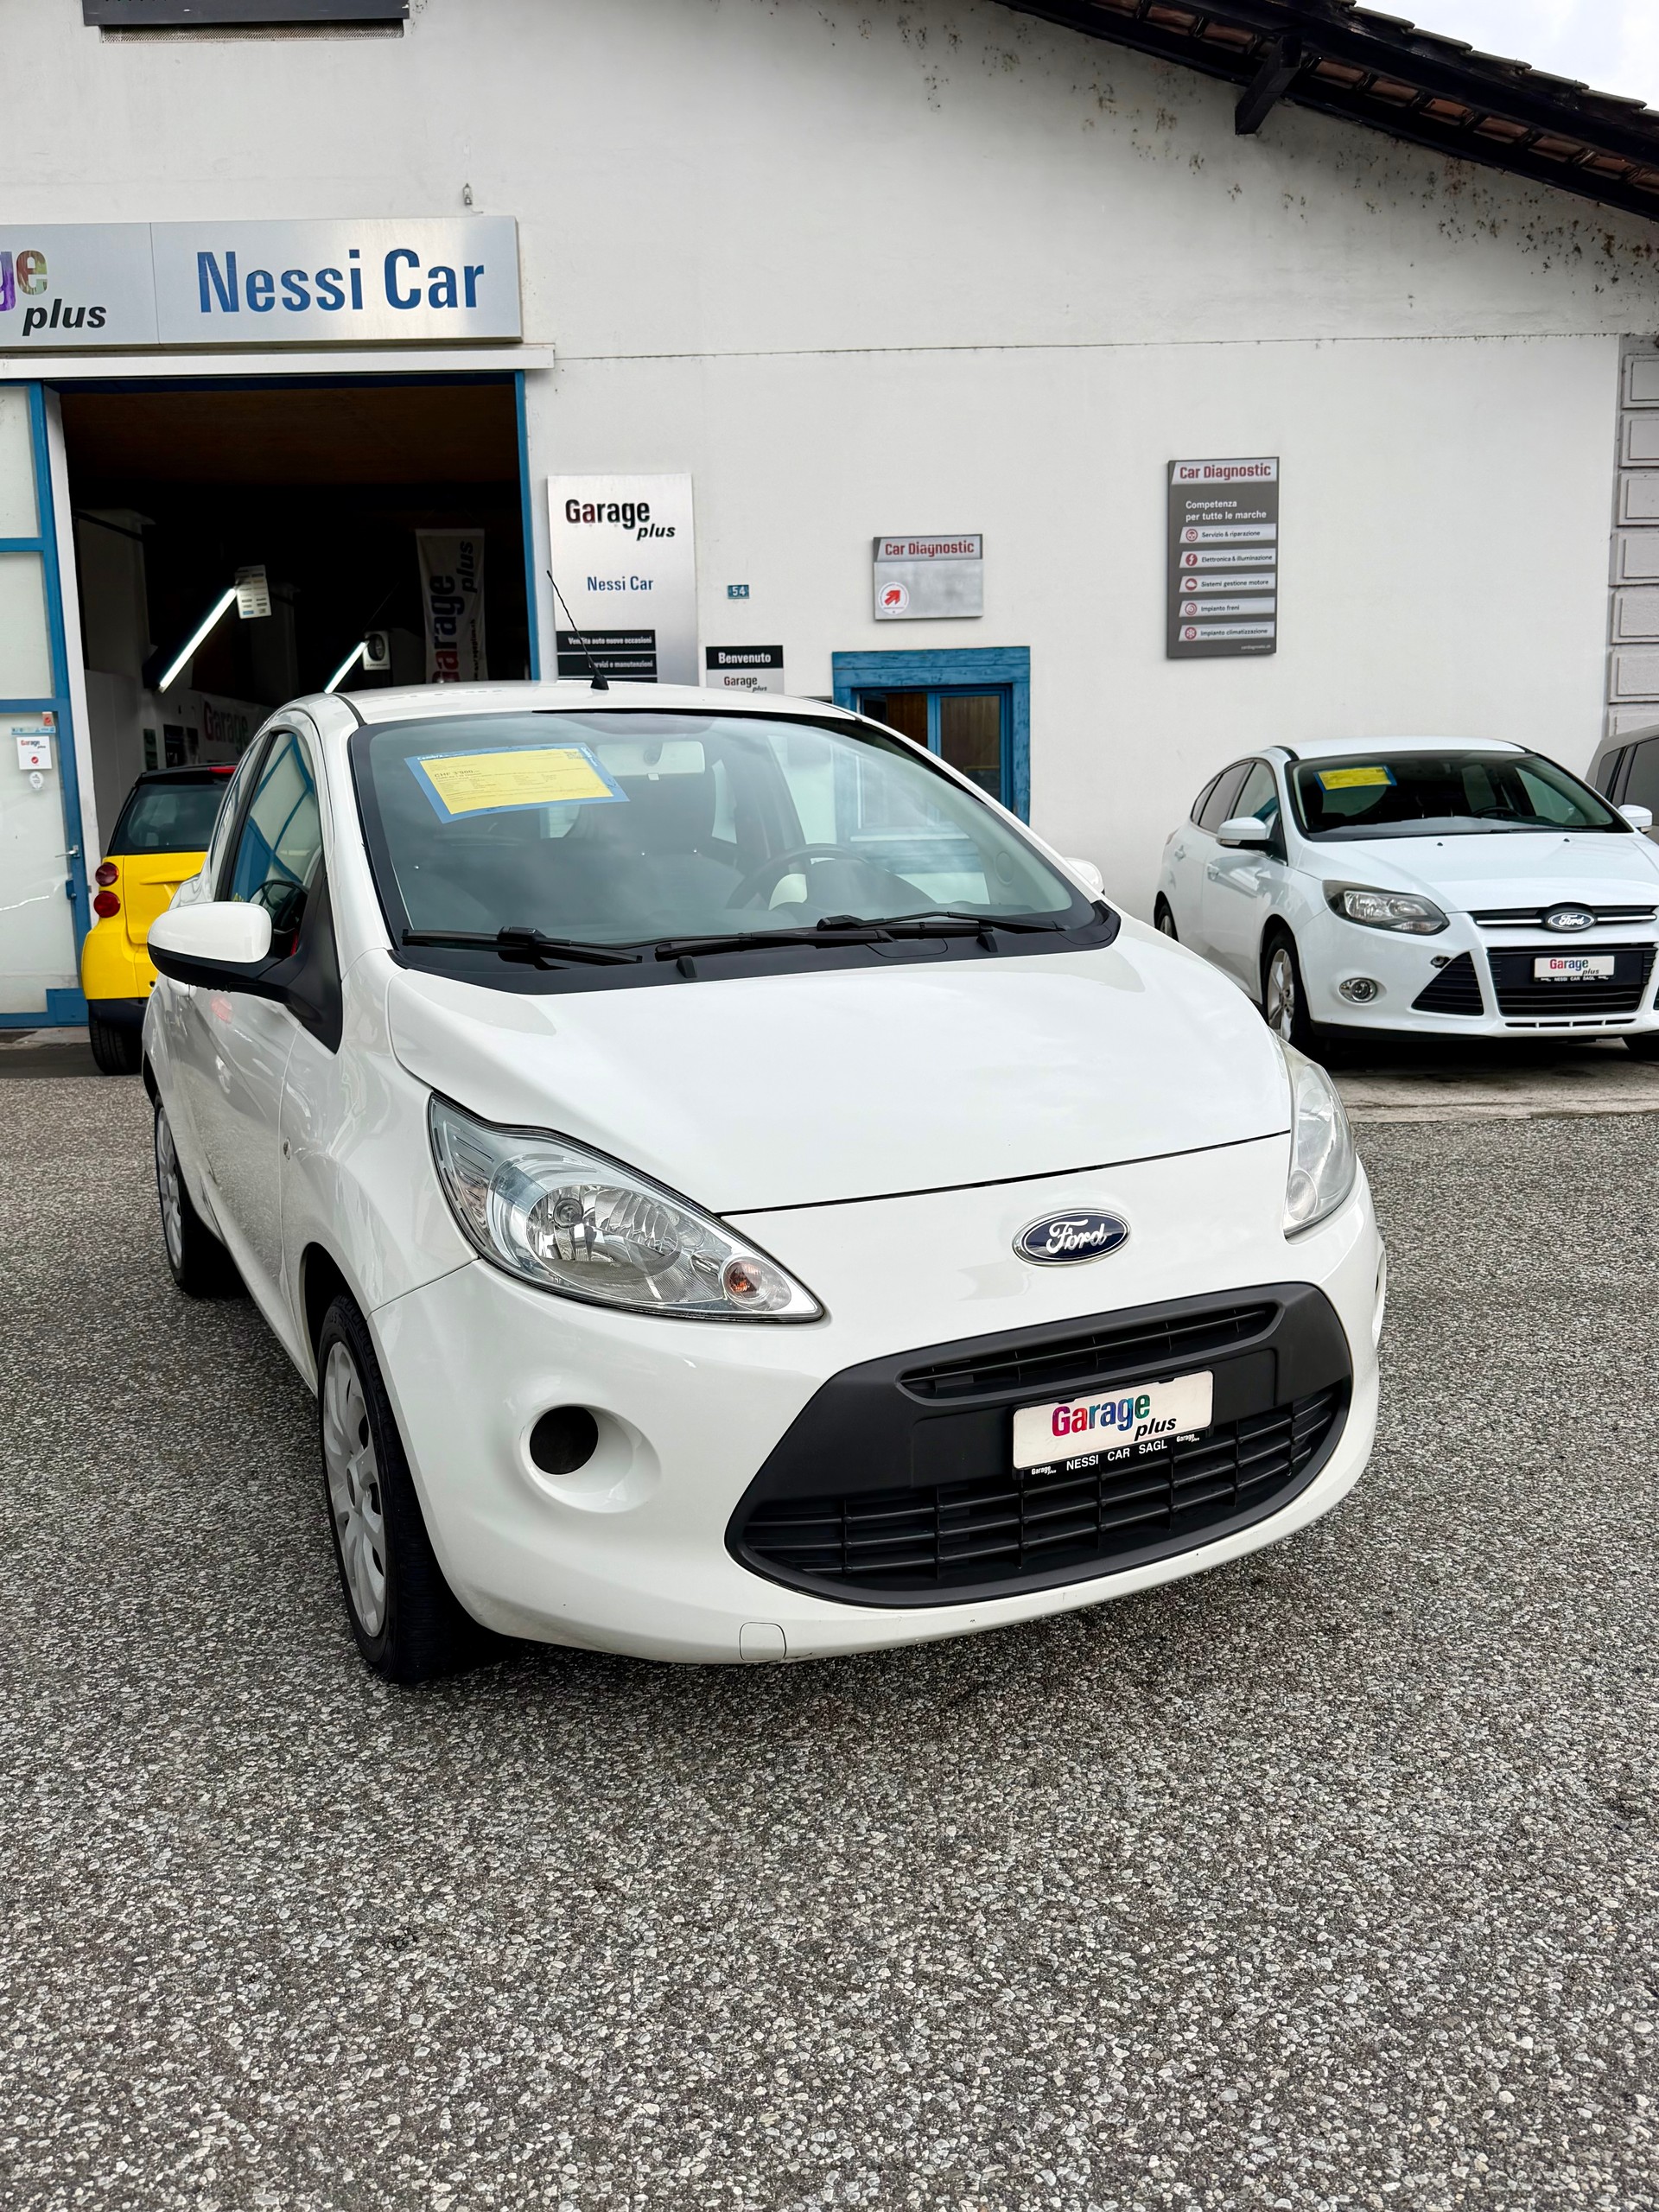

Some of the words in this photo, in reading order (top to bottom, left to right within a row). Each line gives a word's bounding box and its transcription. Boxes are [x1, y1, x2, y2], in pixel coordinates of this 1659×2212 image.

[197, 248, 363, 313] Nessi
[384, 248, 484, 310] Car
[22, 298, 107, 337] plus
[1179, 466, 1200, 479] Car
[1204, 462, 1271, 480] Diagnostic
[1185, 500, 1237, 510] Competenza
[565, 499, 651, 530] Garage
[1185, 513, 1200, 523] per
[1202, 512, 1223, 520] tutte
[1225, 511, 1233, 519] le
[1235, 510, 1267, 519] marche
[636, 523, 676, 541] plus
[1230, 530, 1261, 538] riparazione
[885, 543, 906, 556] Car
[908, 540, 974, 557] Diagnostic
[455, 540, 478, 594] plus
[587, 576, 626, 591] Nessi
[630, 575, 654, 591] Car
[732, 586, 746, 596] 54
[1224, 580, 1247, 588] gestione
[718, 652, 772, 664] Benvenuto
[724, 677, 758, 688] Garage
[1558, 914, 1585, 925] Ford
[1550, 958, 1589, 971] Garage
[1046, 1219, 1107, 1254] Ford
[1052, 1394, 1151, 1437] Garage
[1134, 1418, 1177, 1441] plus
[1066, 1455, 1099, 1471] NESSI
[1107, 1447, 1130, 1461] CAR
[1138, 1440, 1168, 1454] SAGL
